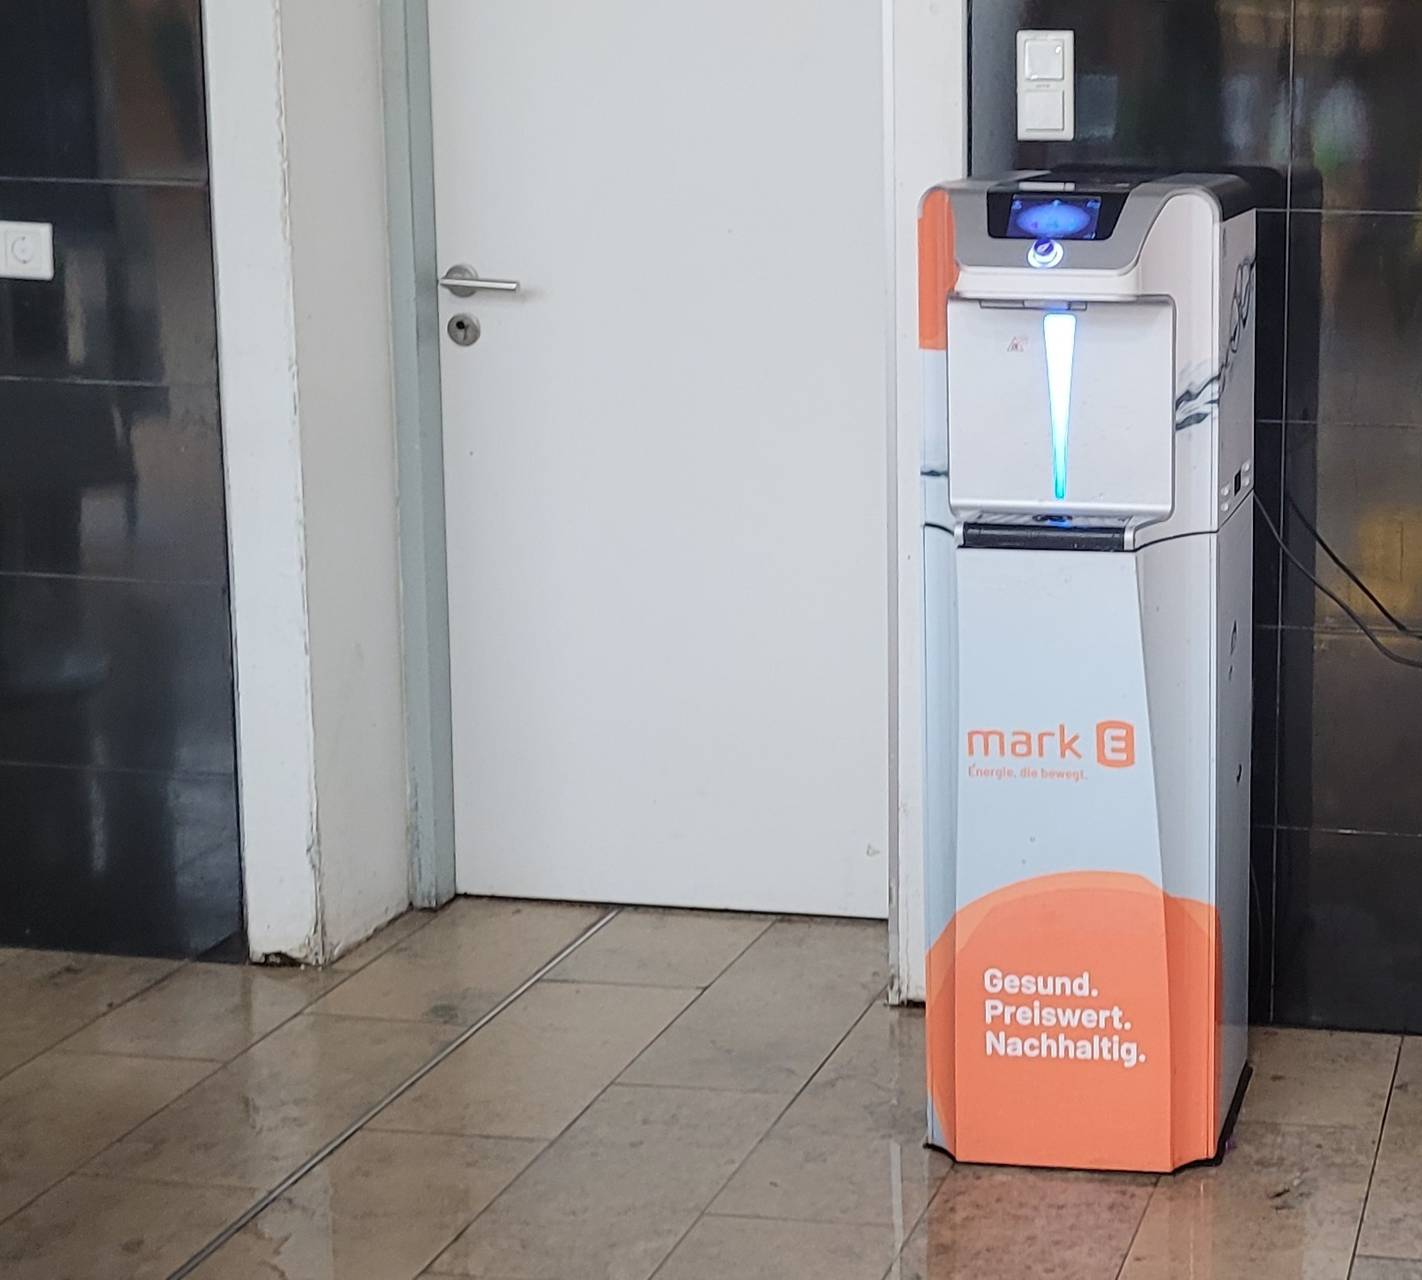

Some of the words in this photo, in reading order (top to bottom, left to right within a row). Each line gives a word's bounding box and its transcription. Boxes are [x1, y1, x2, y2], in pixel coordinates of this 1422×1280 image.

[967, 723, 1083, 759] mark
[1020, 767, 1038, 778] die
[984, 968, 1099, 998] Gesund.
[985, 999, 1132, 1031] Preiswert.
[985, 1030, 1147, 1068] Nachhaltig.
